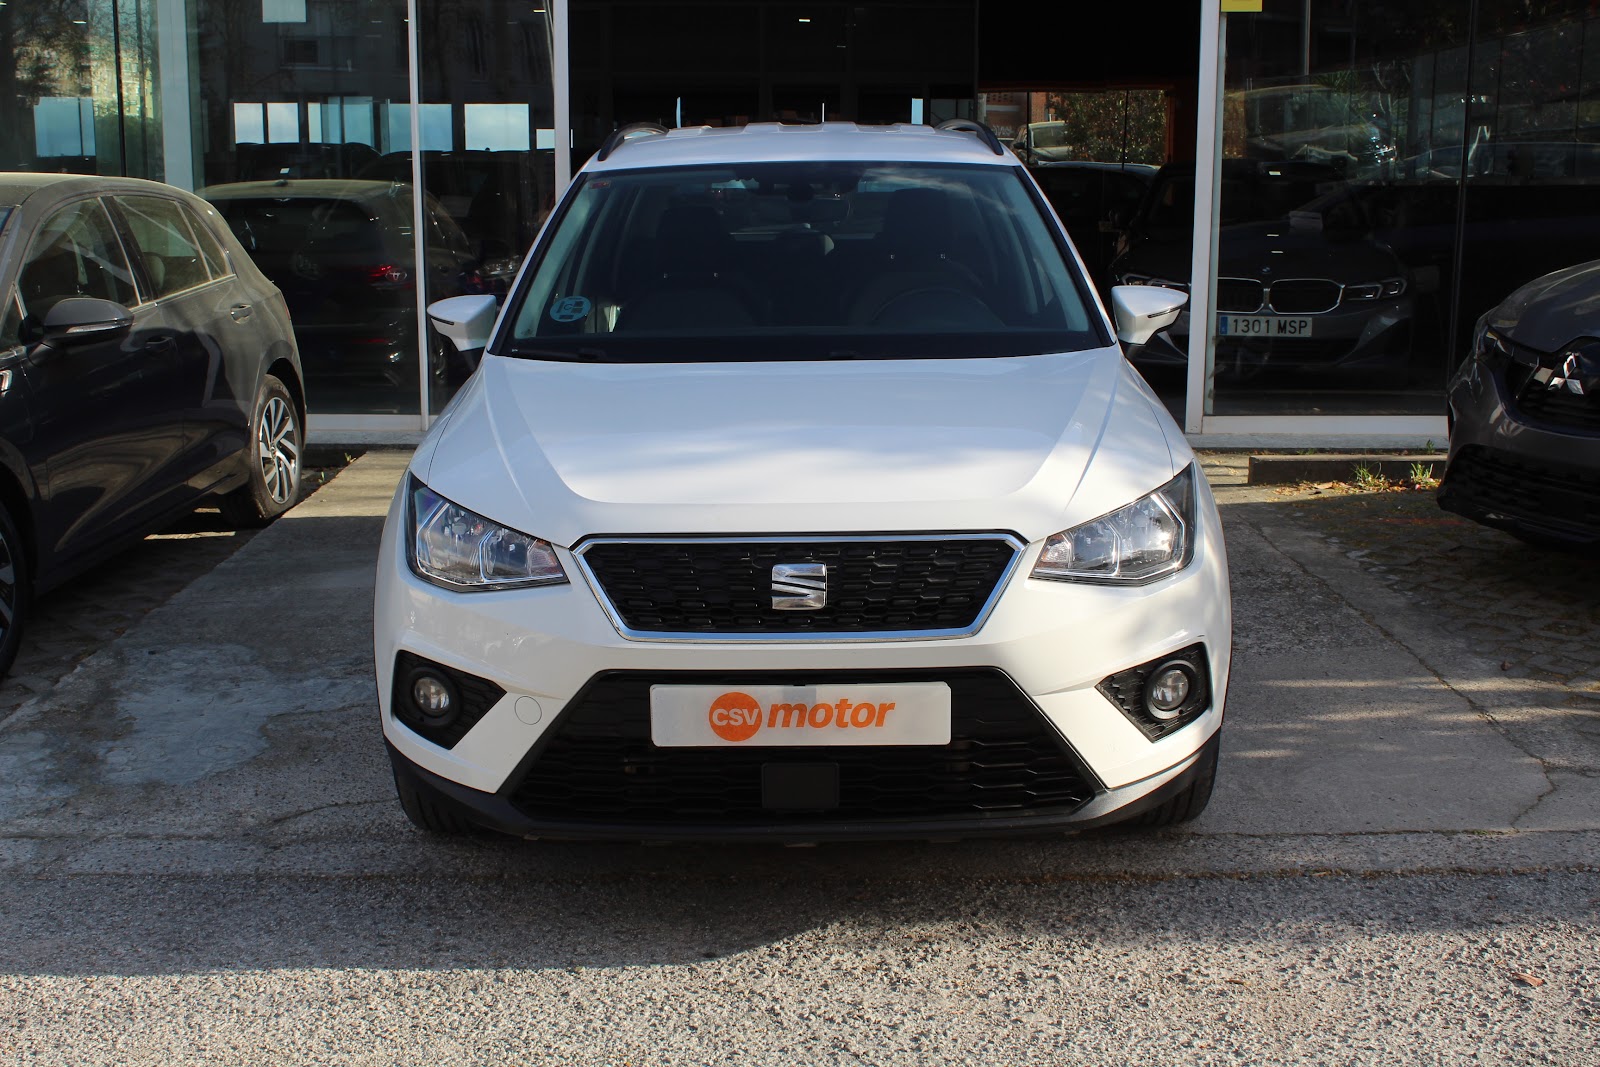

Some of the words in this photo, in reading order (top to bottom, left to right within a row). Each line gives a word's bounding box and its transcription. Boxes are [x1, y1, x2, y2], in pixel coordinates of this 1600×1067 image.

[1233, 318, 1270, 334] 1301
[1277, 319, 1308, 335] MSP
[767, 698, 896, 728] motor
